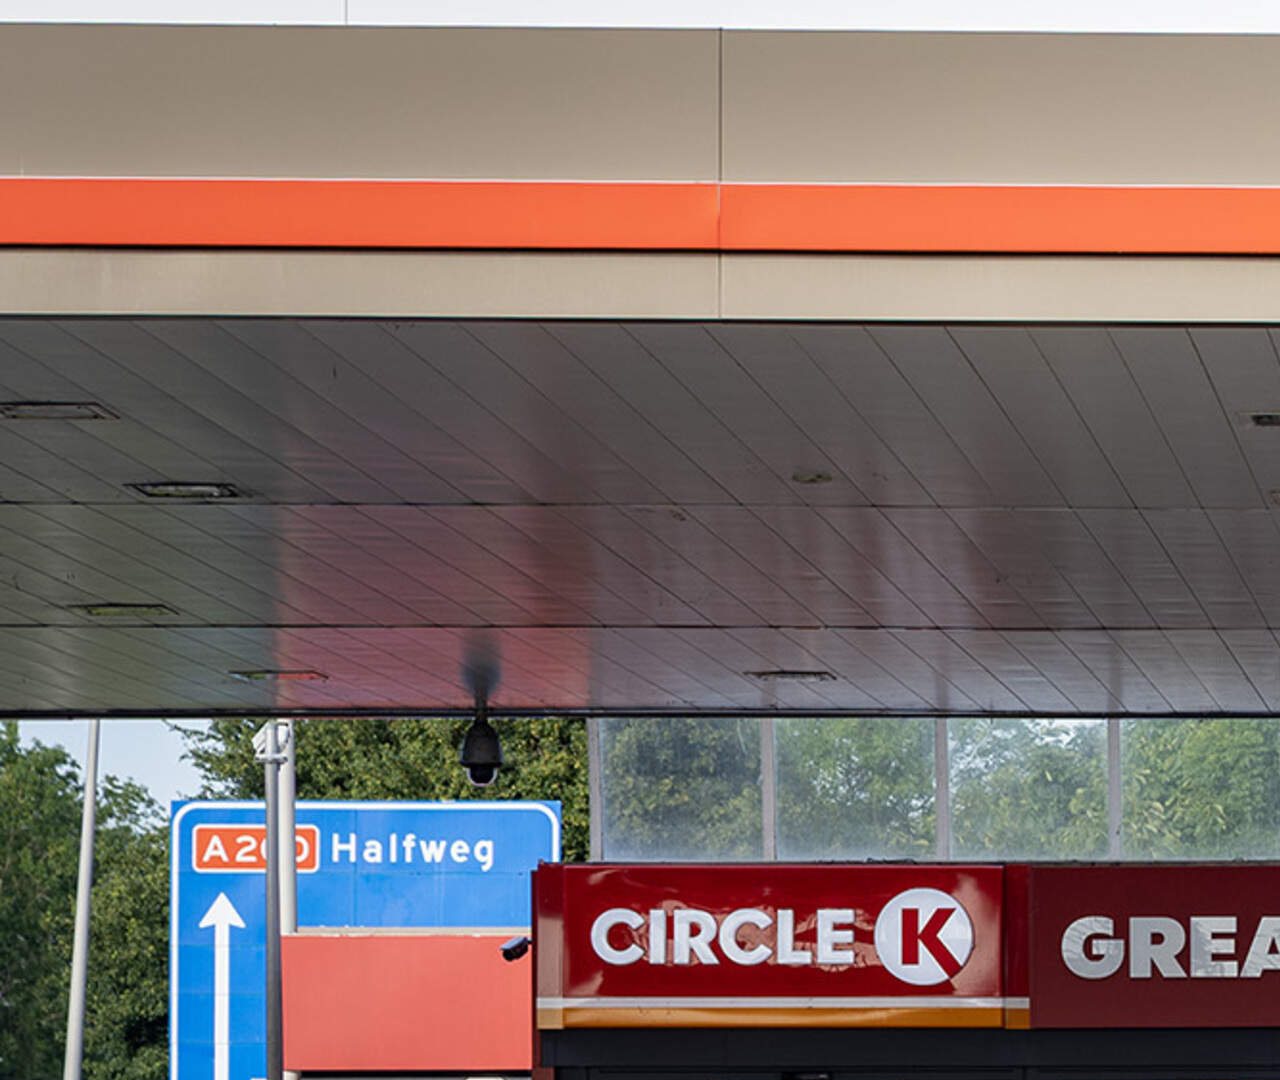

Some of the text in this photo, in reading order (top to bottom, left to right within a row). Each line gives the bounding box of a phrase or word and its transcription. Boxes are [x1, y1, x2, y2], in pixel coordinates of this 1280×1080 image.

[202, 833, 495, 872] A20 Halfweg
[590, 907, 855, 966] CIRCLE
